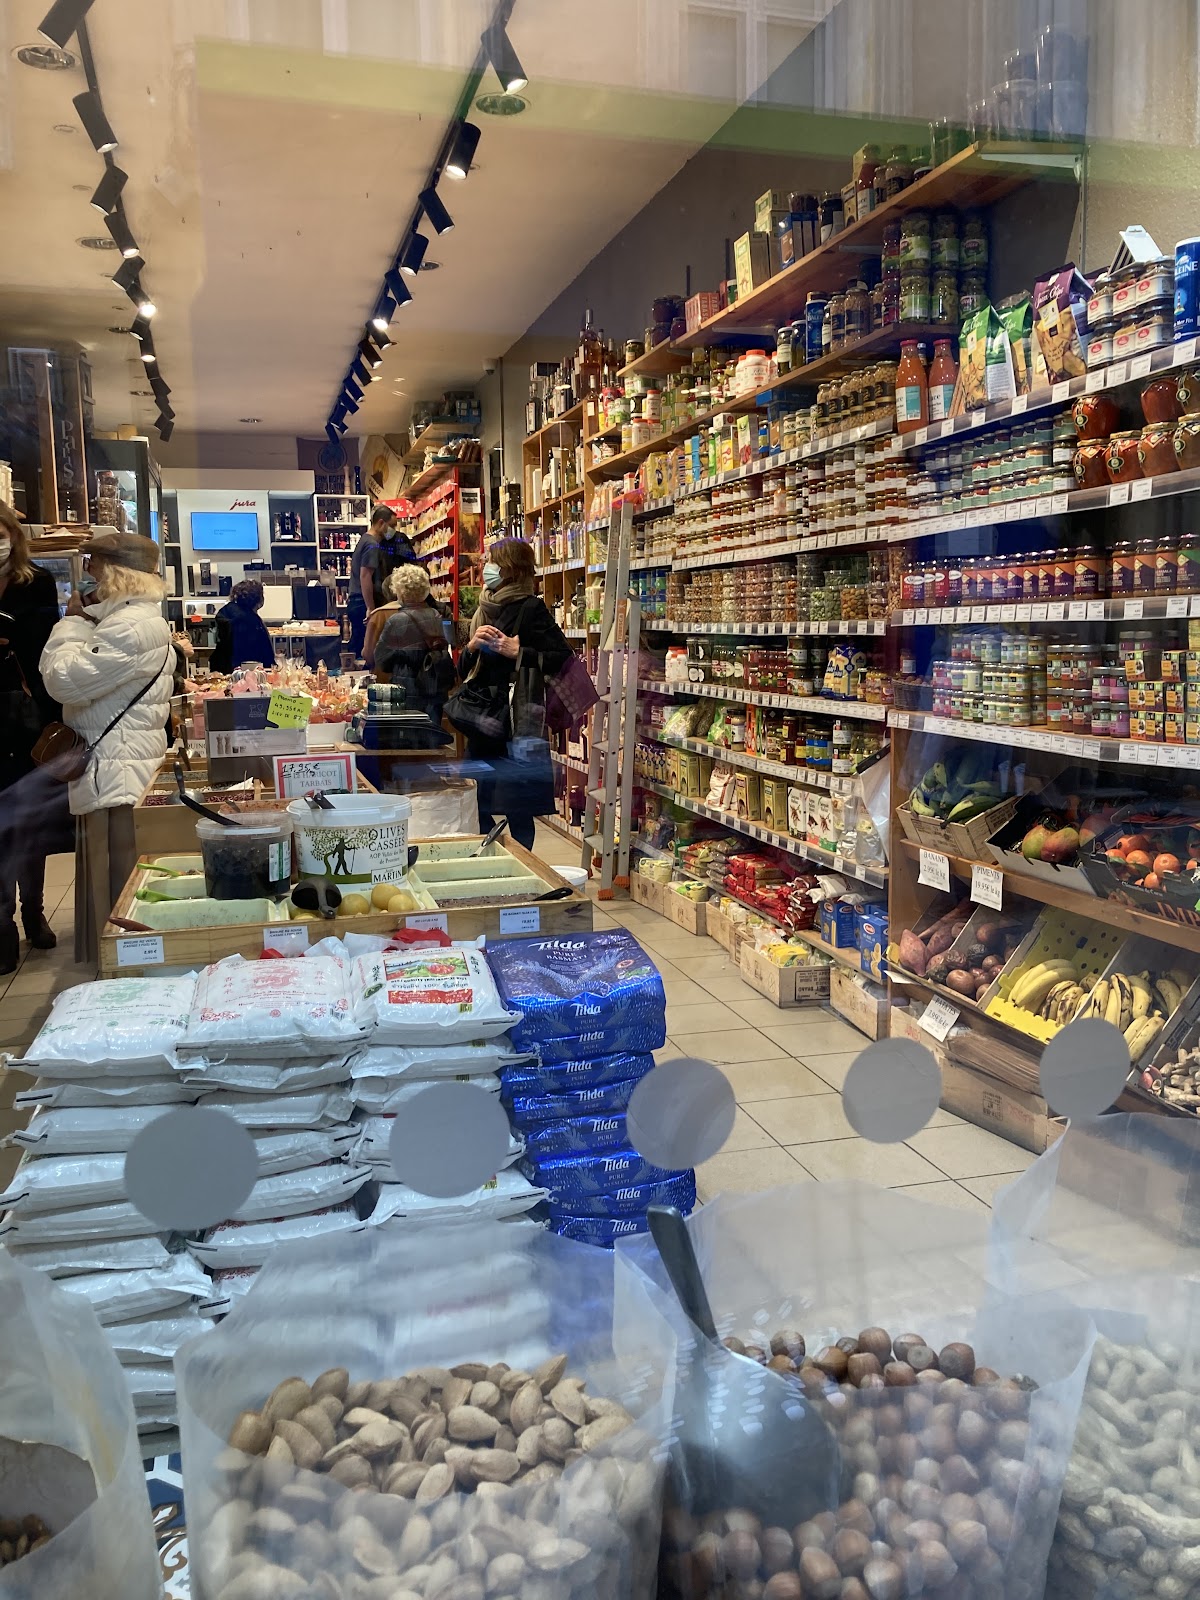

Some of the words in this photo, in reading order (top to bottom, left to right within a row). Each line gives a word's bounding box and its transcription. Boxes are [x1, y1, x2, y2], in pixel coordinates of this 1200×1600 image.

[228, 498, 257, 511] jura
[302, 770, 337, 779] HARICOT
[300, 779, 332, 788] TARBAIS
[368, 823, 406, 841] OLIVES
[923, 850, 945, 864] BANANE
[976, 865, 1000, 880] PIMENTS
[528, 940, 586, 951] Tilda
[570, 1003, 601, 1017] Tilda
[934, 997, 956, 1016] PATATES
[560, 1060, 592, 1073] Tilda
[574, 1088, 605, 1101] Tilda
[588, 1119, 618, 1132] Tilda
[598, 1158, 630, 1172] Tilda
[609, 1219, 638, 1233] Tilda
